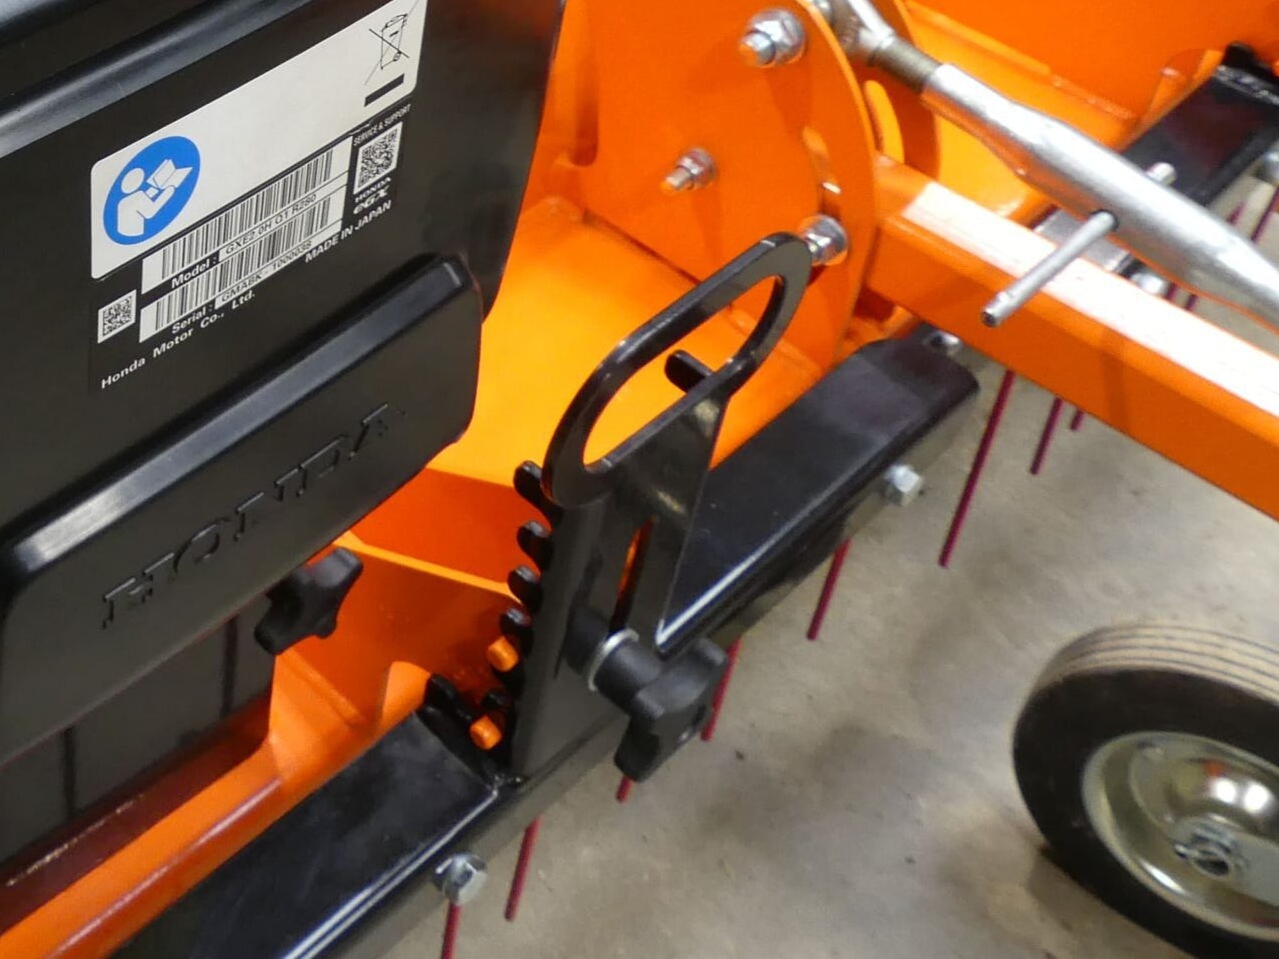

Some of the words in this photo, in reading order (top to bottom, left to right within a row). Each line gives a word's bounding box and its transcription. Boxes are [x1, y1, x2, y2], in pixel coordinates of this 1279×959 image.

[354, 176, 392, 203] HONDA
[305, 234, 340, 263] MADE
[341, 225, 354, 240] IN
[354, 200, 392, 231] JAPAN
[101, 357, 146, 389] Honda
[152, 328, 194, 358] Motor
[231, 290, 256, 310] Ltd.
